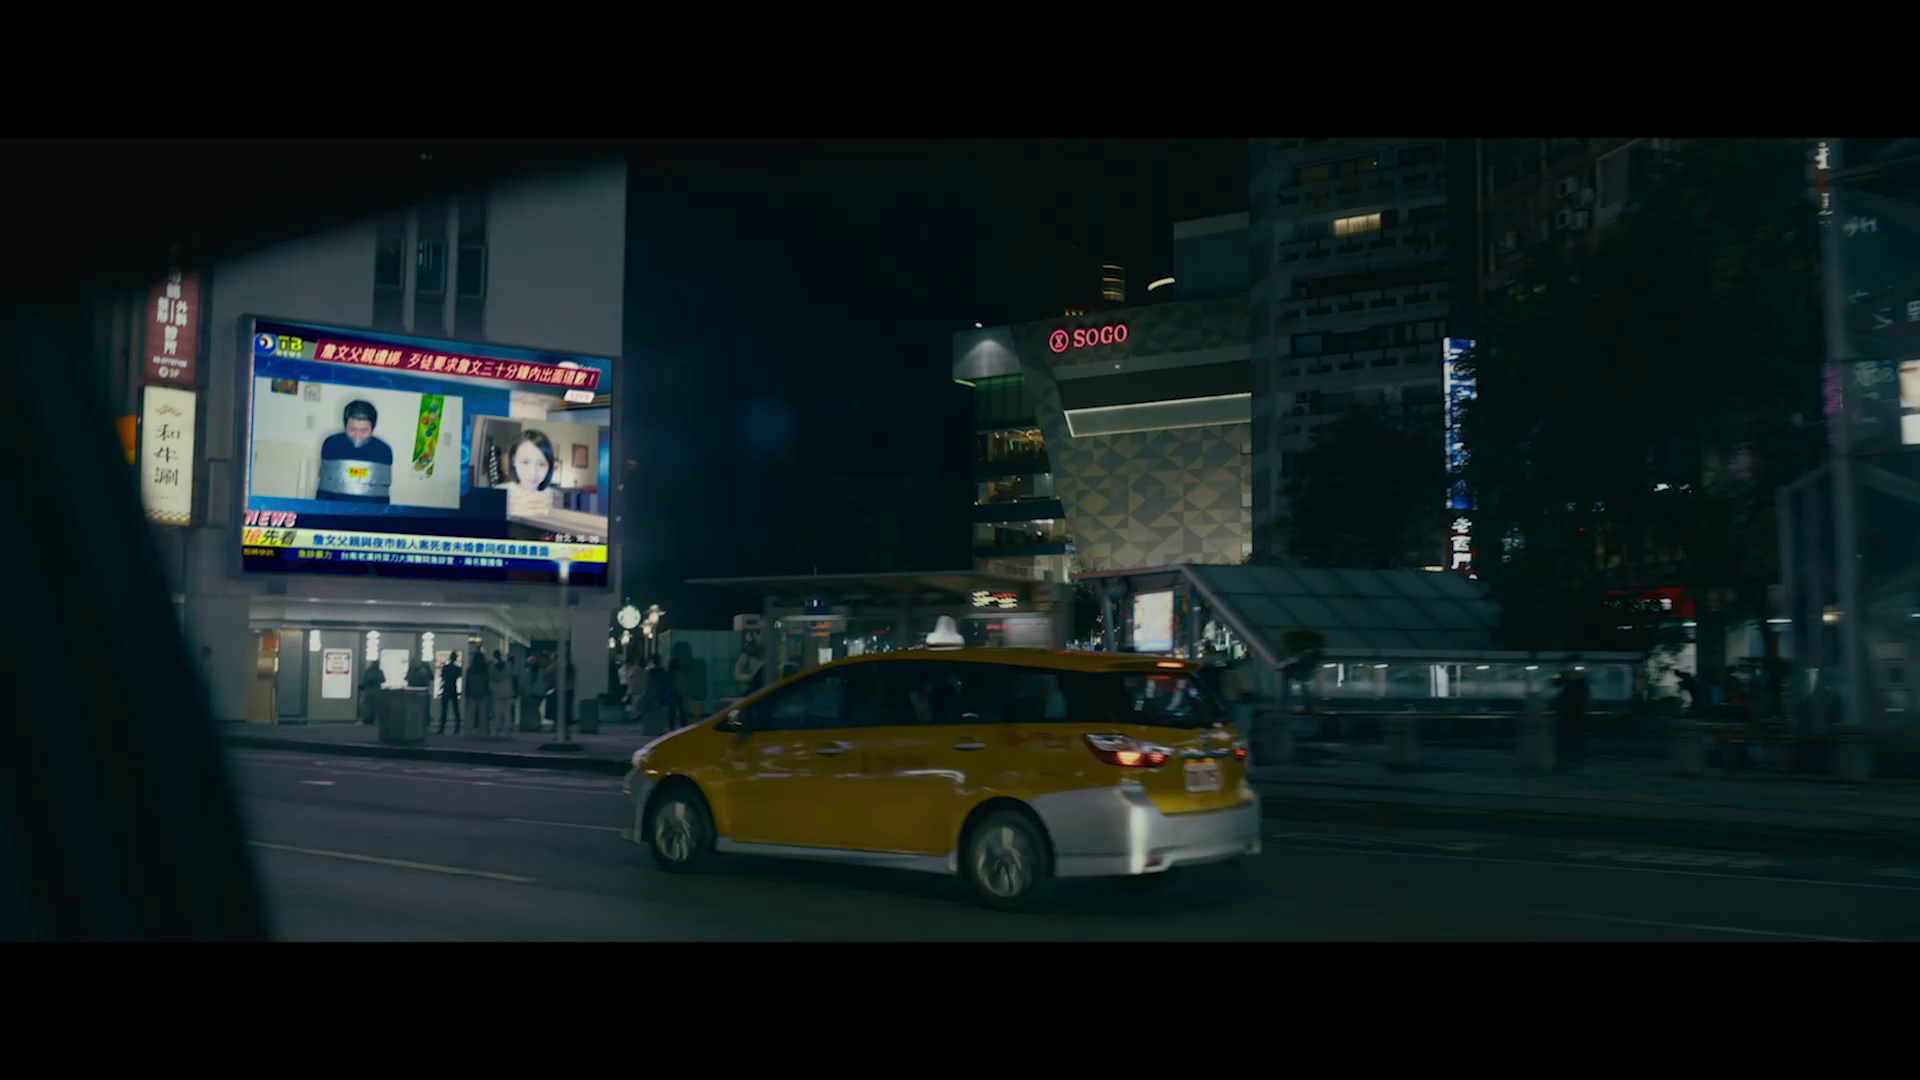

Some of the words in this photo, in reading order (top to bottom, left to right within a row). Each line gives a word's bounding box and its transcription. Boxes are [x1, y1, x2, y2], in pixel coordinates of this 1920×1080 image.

[1073, 324, 1128, 348] SOGO
[320, 343, 402, 366] 詹文父親遭綁
[154, 424, 180, 486] 和牛涮
